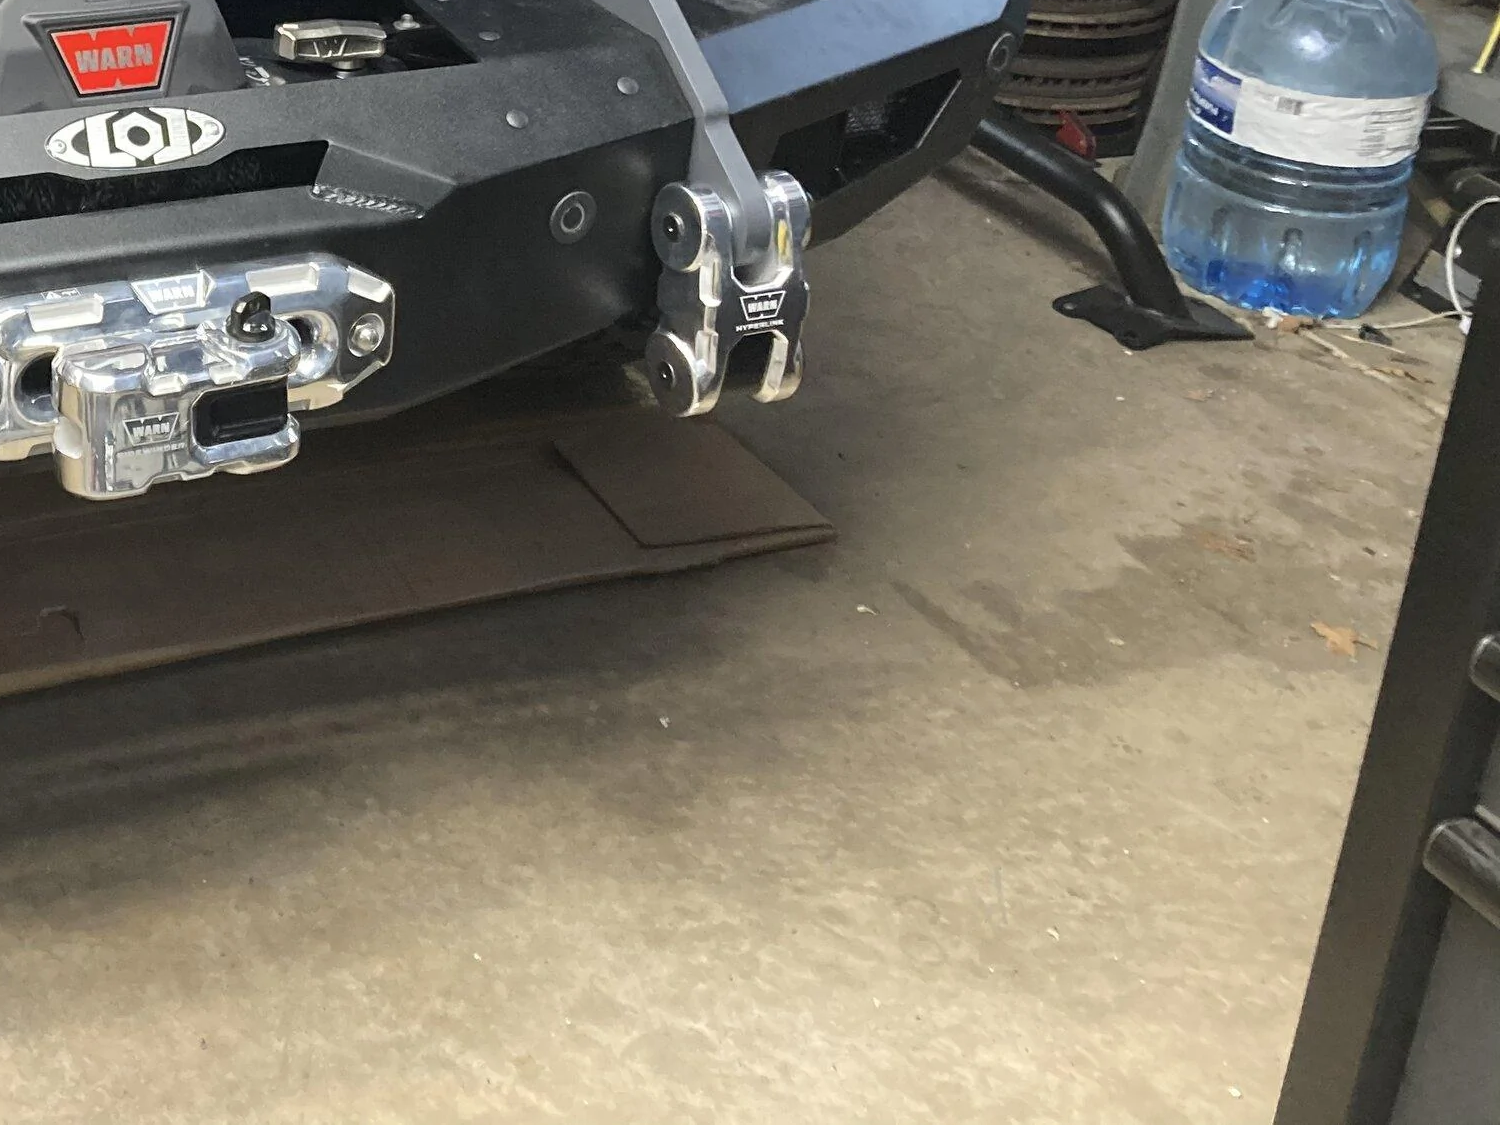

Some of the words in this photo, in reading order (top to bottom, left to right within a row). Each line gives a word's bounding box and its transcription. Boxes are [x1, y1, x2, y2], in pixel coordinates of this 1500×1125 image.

[75, 43, 153, 73] WARN
[147, 285, 195, 303] WARN
[747, 299, 778, 313] WARN
[132, 422, 170, 437] WARN
